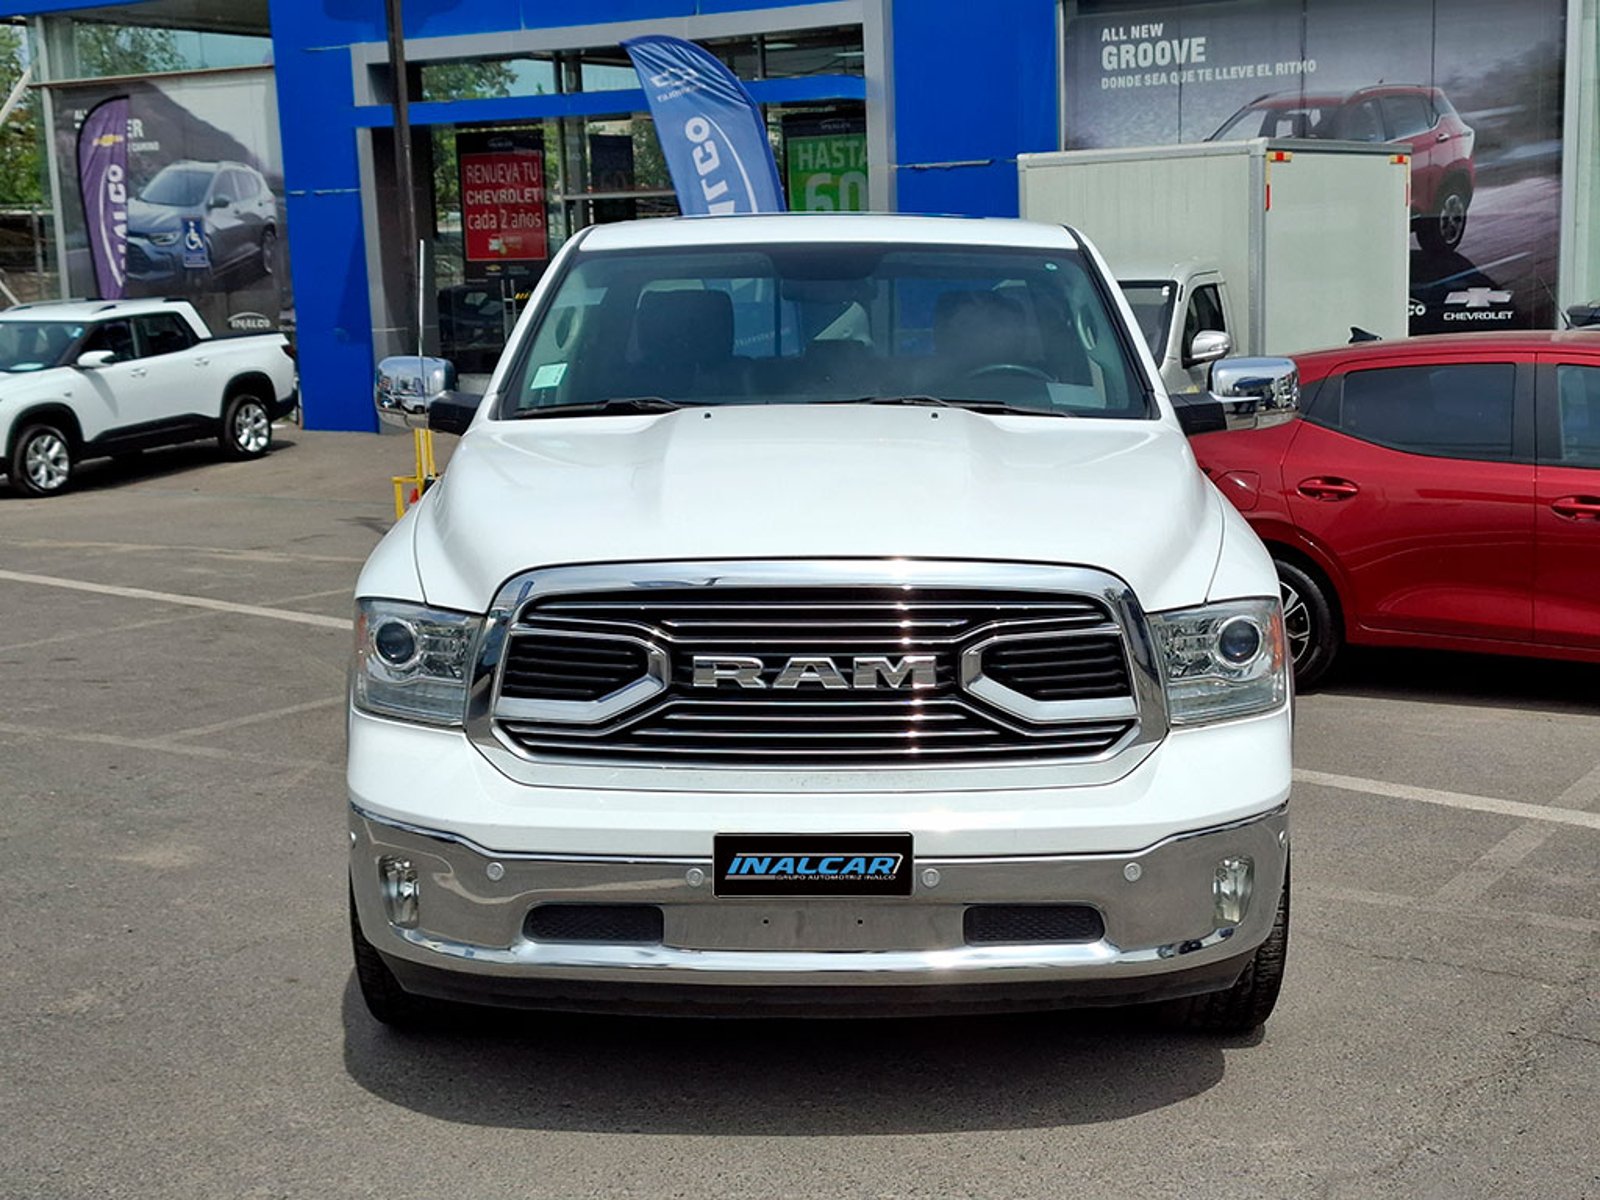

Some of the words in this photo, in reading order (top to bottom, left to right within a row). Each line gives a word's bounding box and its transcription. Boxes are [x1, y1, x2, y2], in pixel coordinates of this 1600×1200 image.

[1101, 28, 1127, 42] ALL
[1131, 23, 1164, 38] NEW
[1101, 37, 1206, 71] GROOVE
[1101, 74, 1141, 89] DONDE
[1144, 72, 1168, 86] SEA
[1170, 70, 1195, 84] QUE
[1199, 69, 1213, 83] TE
[1215, 65, 1255, 81] LLEVE
[1257, 63, 1272, 77] EL
[1275, 60, 1317, 76] RITMO
[798, 140, 867, 171] HASTA
[466, 163, 520, 184] RENUEVA
[522, 161, 538, 182] TU
[466, 187, 541, 206] CHEVROLET
[805, 171, 868, 212] 60
[468, 209, 497, 230] cada
[500, 209, 508, 229] 2
[512, 208, 542, 229] años
[1443, 311, 1514, 321] CHEVROLET
[692, 655, 937, 689] RAM
[727, 856, 896, 875] INALCAR
